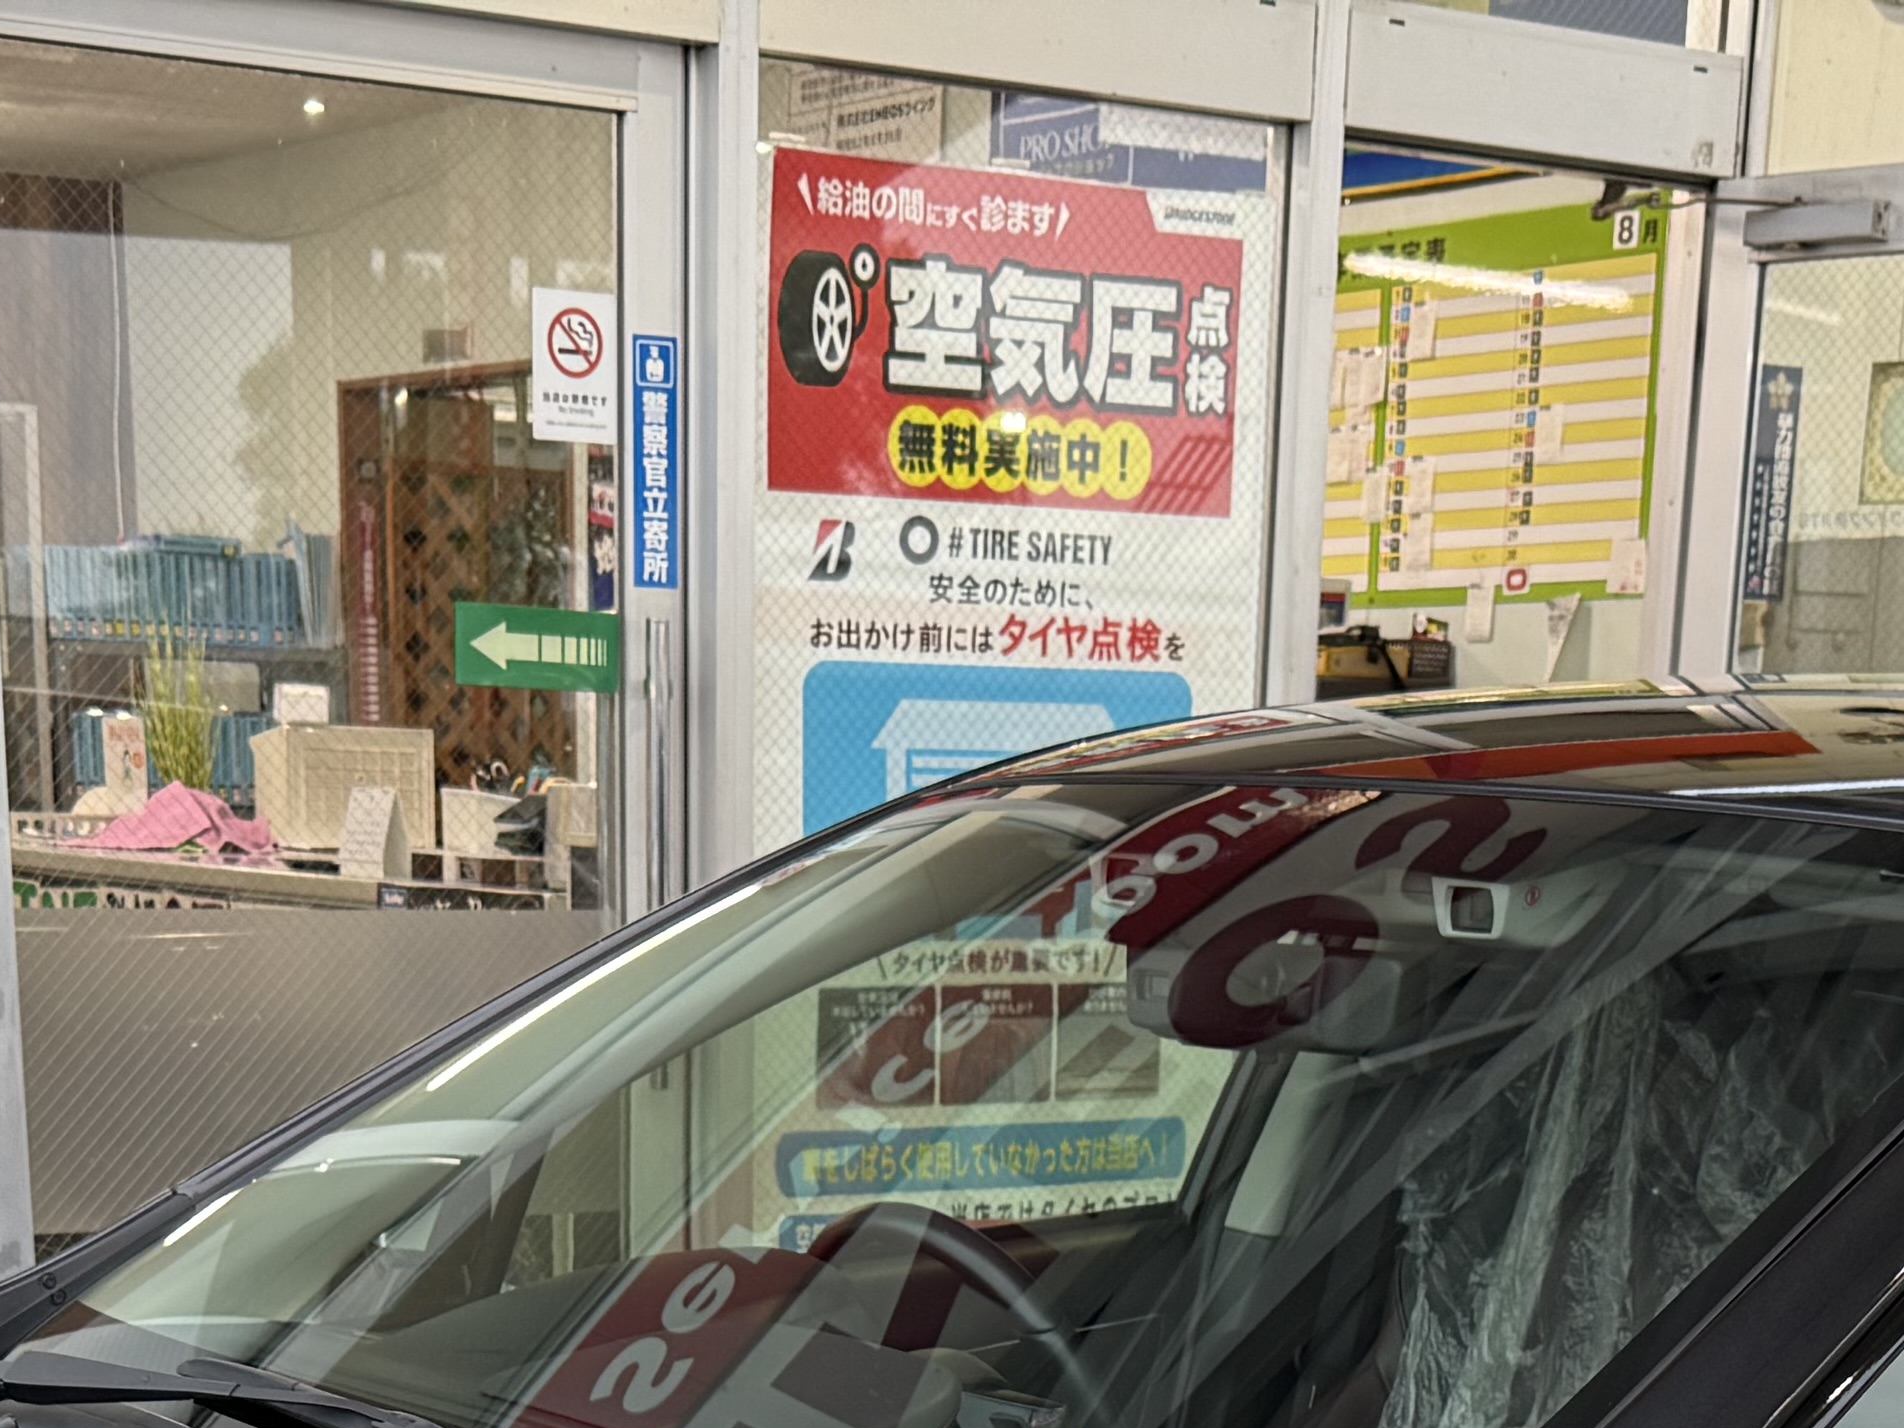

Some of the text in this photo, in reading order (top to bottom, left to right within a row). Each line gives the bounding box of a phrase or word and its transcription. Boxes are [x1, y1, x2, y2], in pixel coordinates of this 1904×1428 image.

[1061, 124, 1110, 158] SHO
[817, 175, 1054, 237] 給油の間にすぐ診ます
[884, 255, 1182, 412] 空気圧
[642, 391, 668, 583] 警察官立寄所
[1026, 530, 1112, 566] SAFETY
[809, 612, 1186, 663] お出かけ前にはタイヤ点検を
